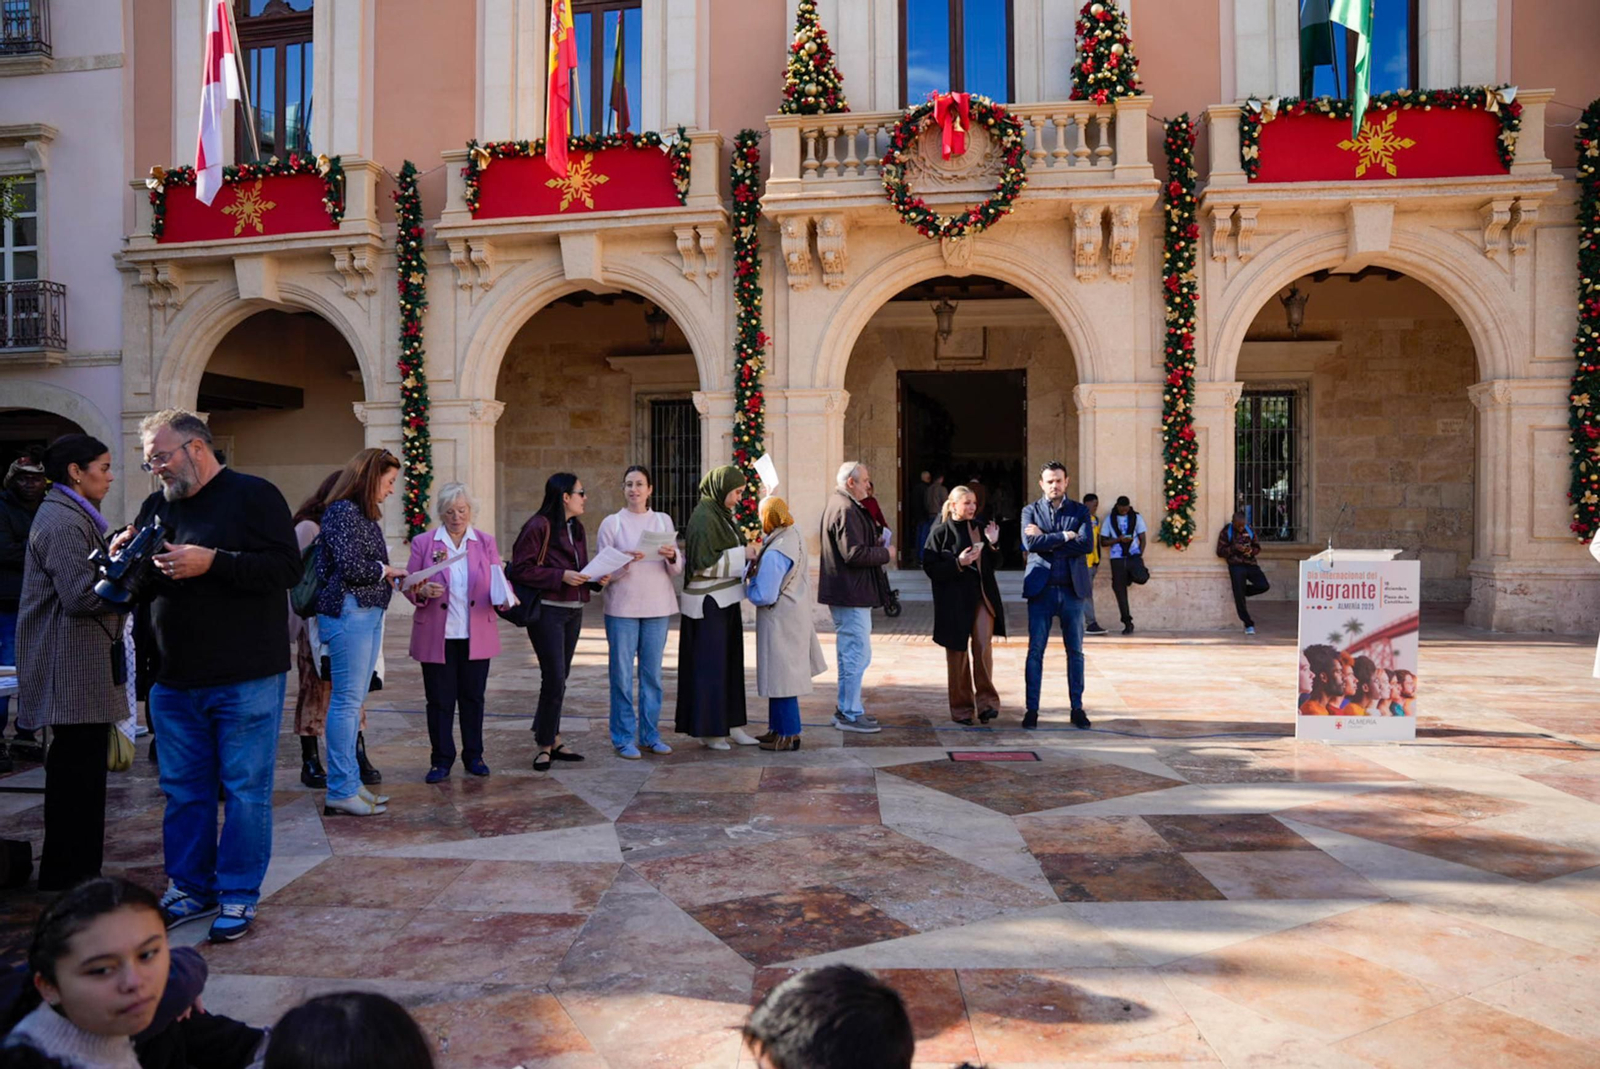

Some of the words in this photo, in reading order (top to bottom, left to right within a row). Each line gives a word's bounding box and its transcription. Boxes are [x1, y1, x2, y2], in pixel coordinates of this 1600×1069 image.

[1366, 572, 1378, 580] del
[1306, 580, 1376, 601] Migrante
[1361, 602, 1375, 610] 2025
